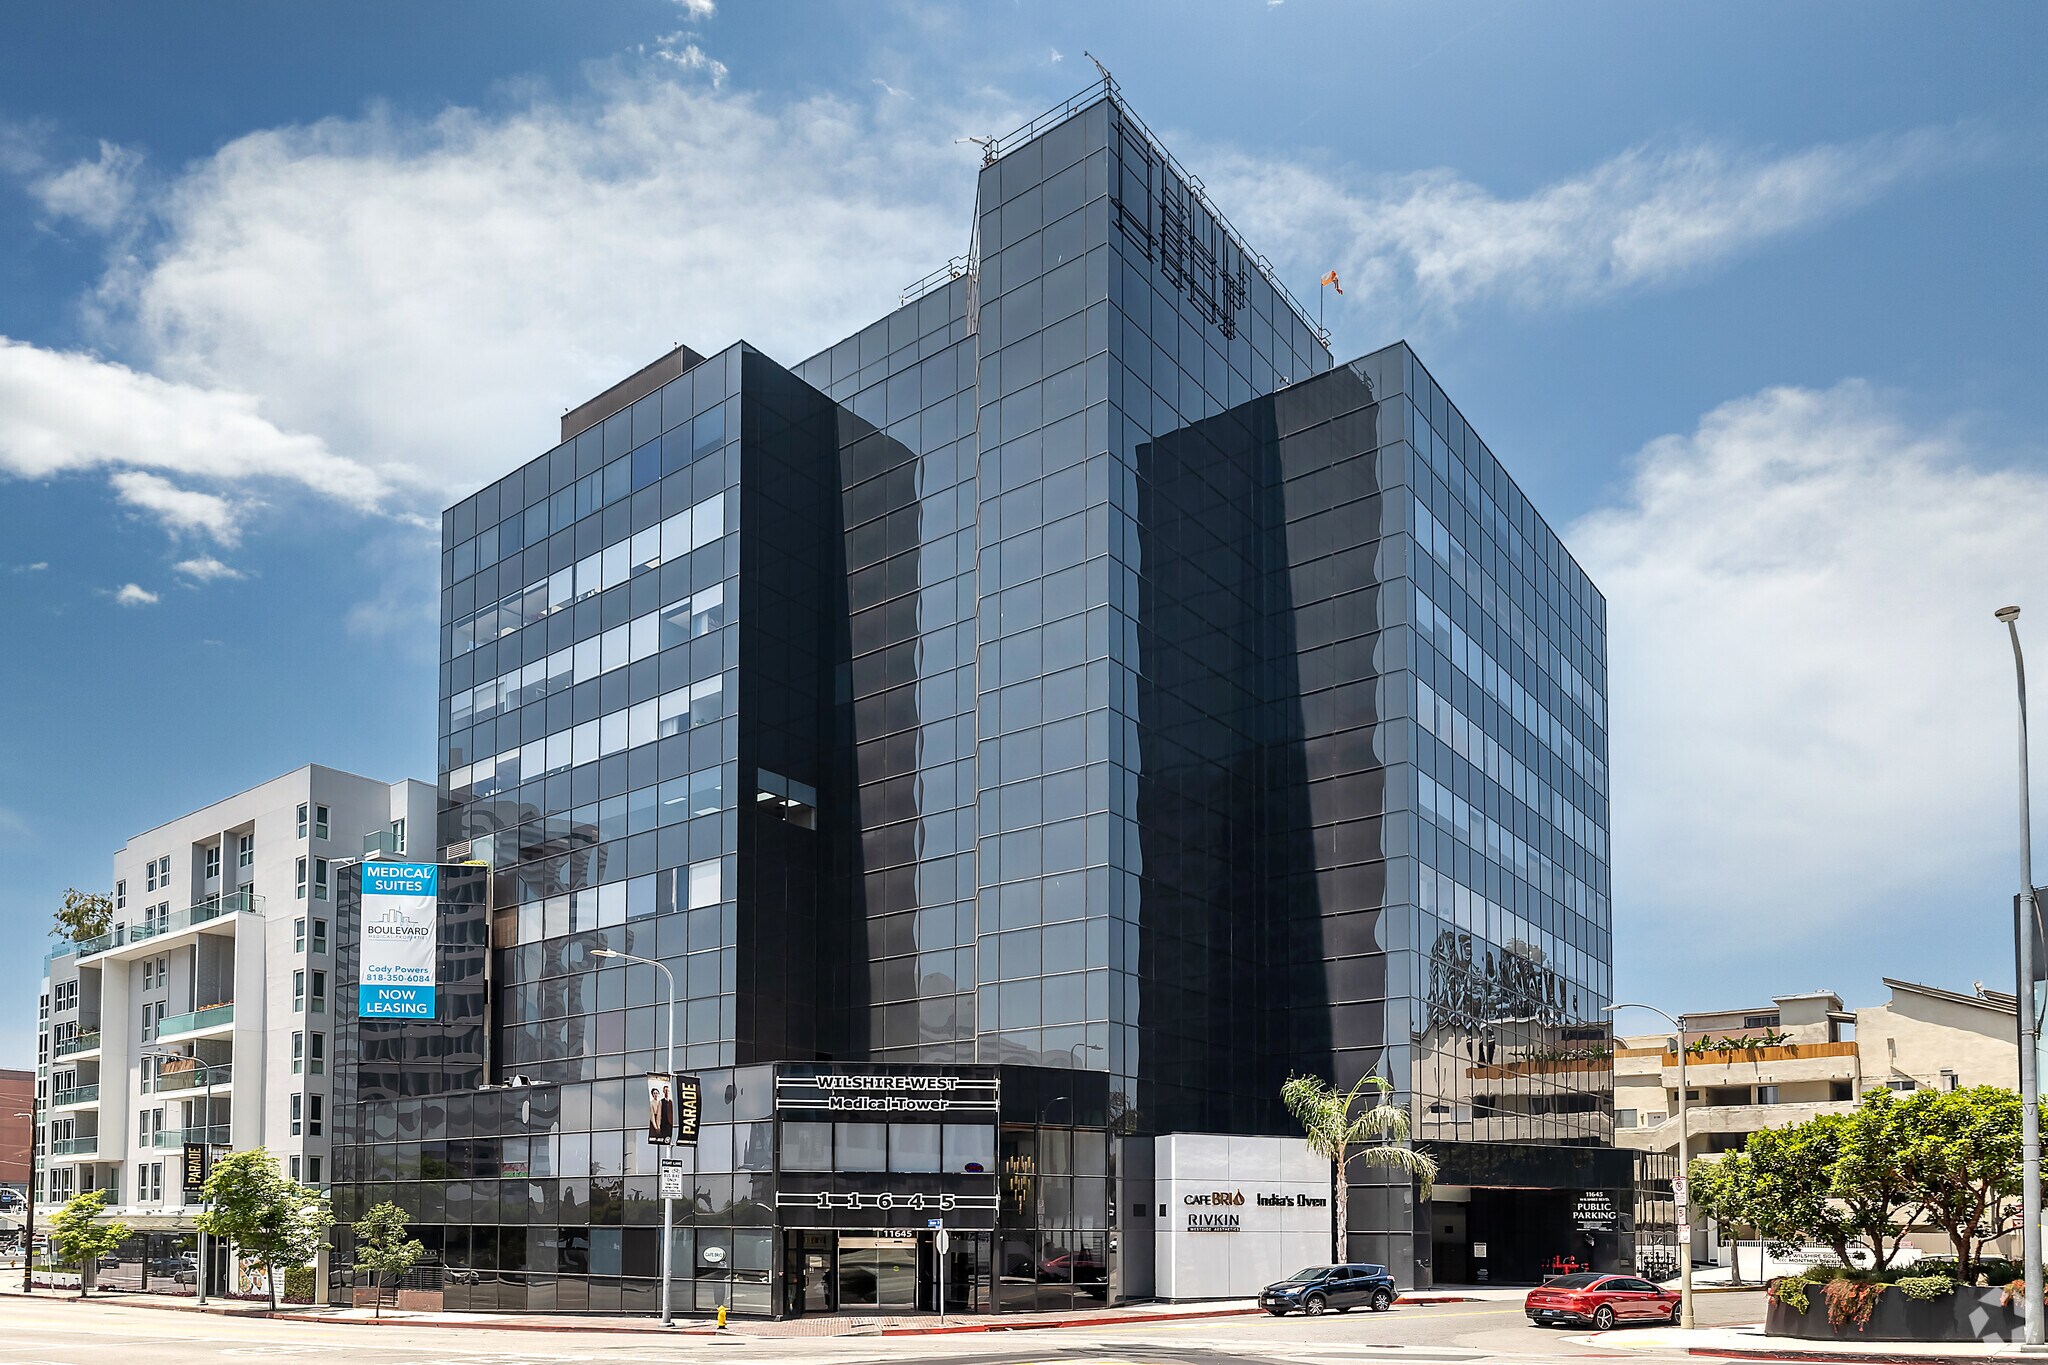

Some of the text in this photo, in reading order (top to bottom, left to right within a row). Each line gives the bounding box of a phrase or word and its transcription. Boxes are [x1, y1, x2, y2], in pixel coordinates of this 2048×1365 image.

[367, 866, 431, 878] MEDICAL
[375, 880, 422, 891] SUITES
[367, 925, 429, 936] BOULEVARD
[368, 964, 429, 974] Cody Powers
[366, 973, 430, 982] 818-350-6084
[378, 989, 416, 1000] NOW
[366, 1002, 427, 1014] LEASING
[816, 1075, 959, 1091] WILSHIRE WEST
[681, 1082, 697, 1135] PARADE
[828, 1096, 949, 1111] Medical Tower
[188, 1147, 201, 1184] PARADE
[1184, 1194, 1211, 1206] CAFE
[1256, 1193, 1327, 1207] India's Oven
[1577, 1203, 1612, 1211] PUBLIC
[1188, 1214, 1240, 1226] RIVKIN
[1572, 1211, 1616, 1220] PARKING
[883, 1230, 912, 1238] 11645
